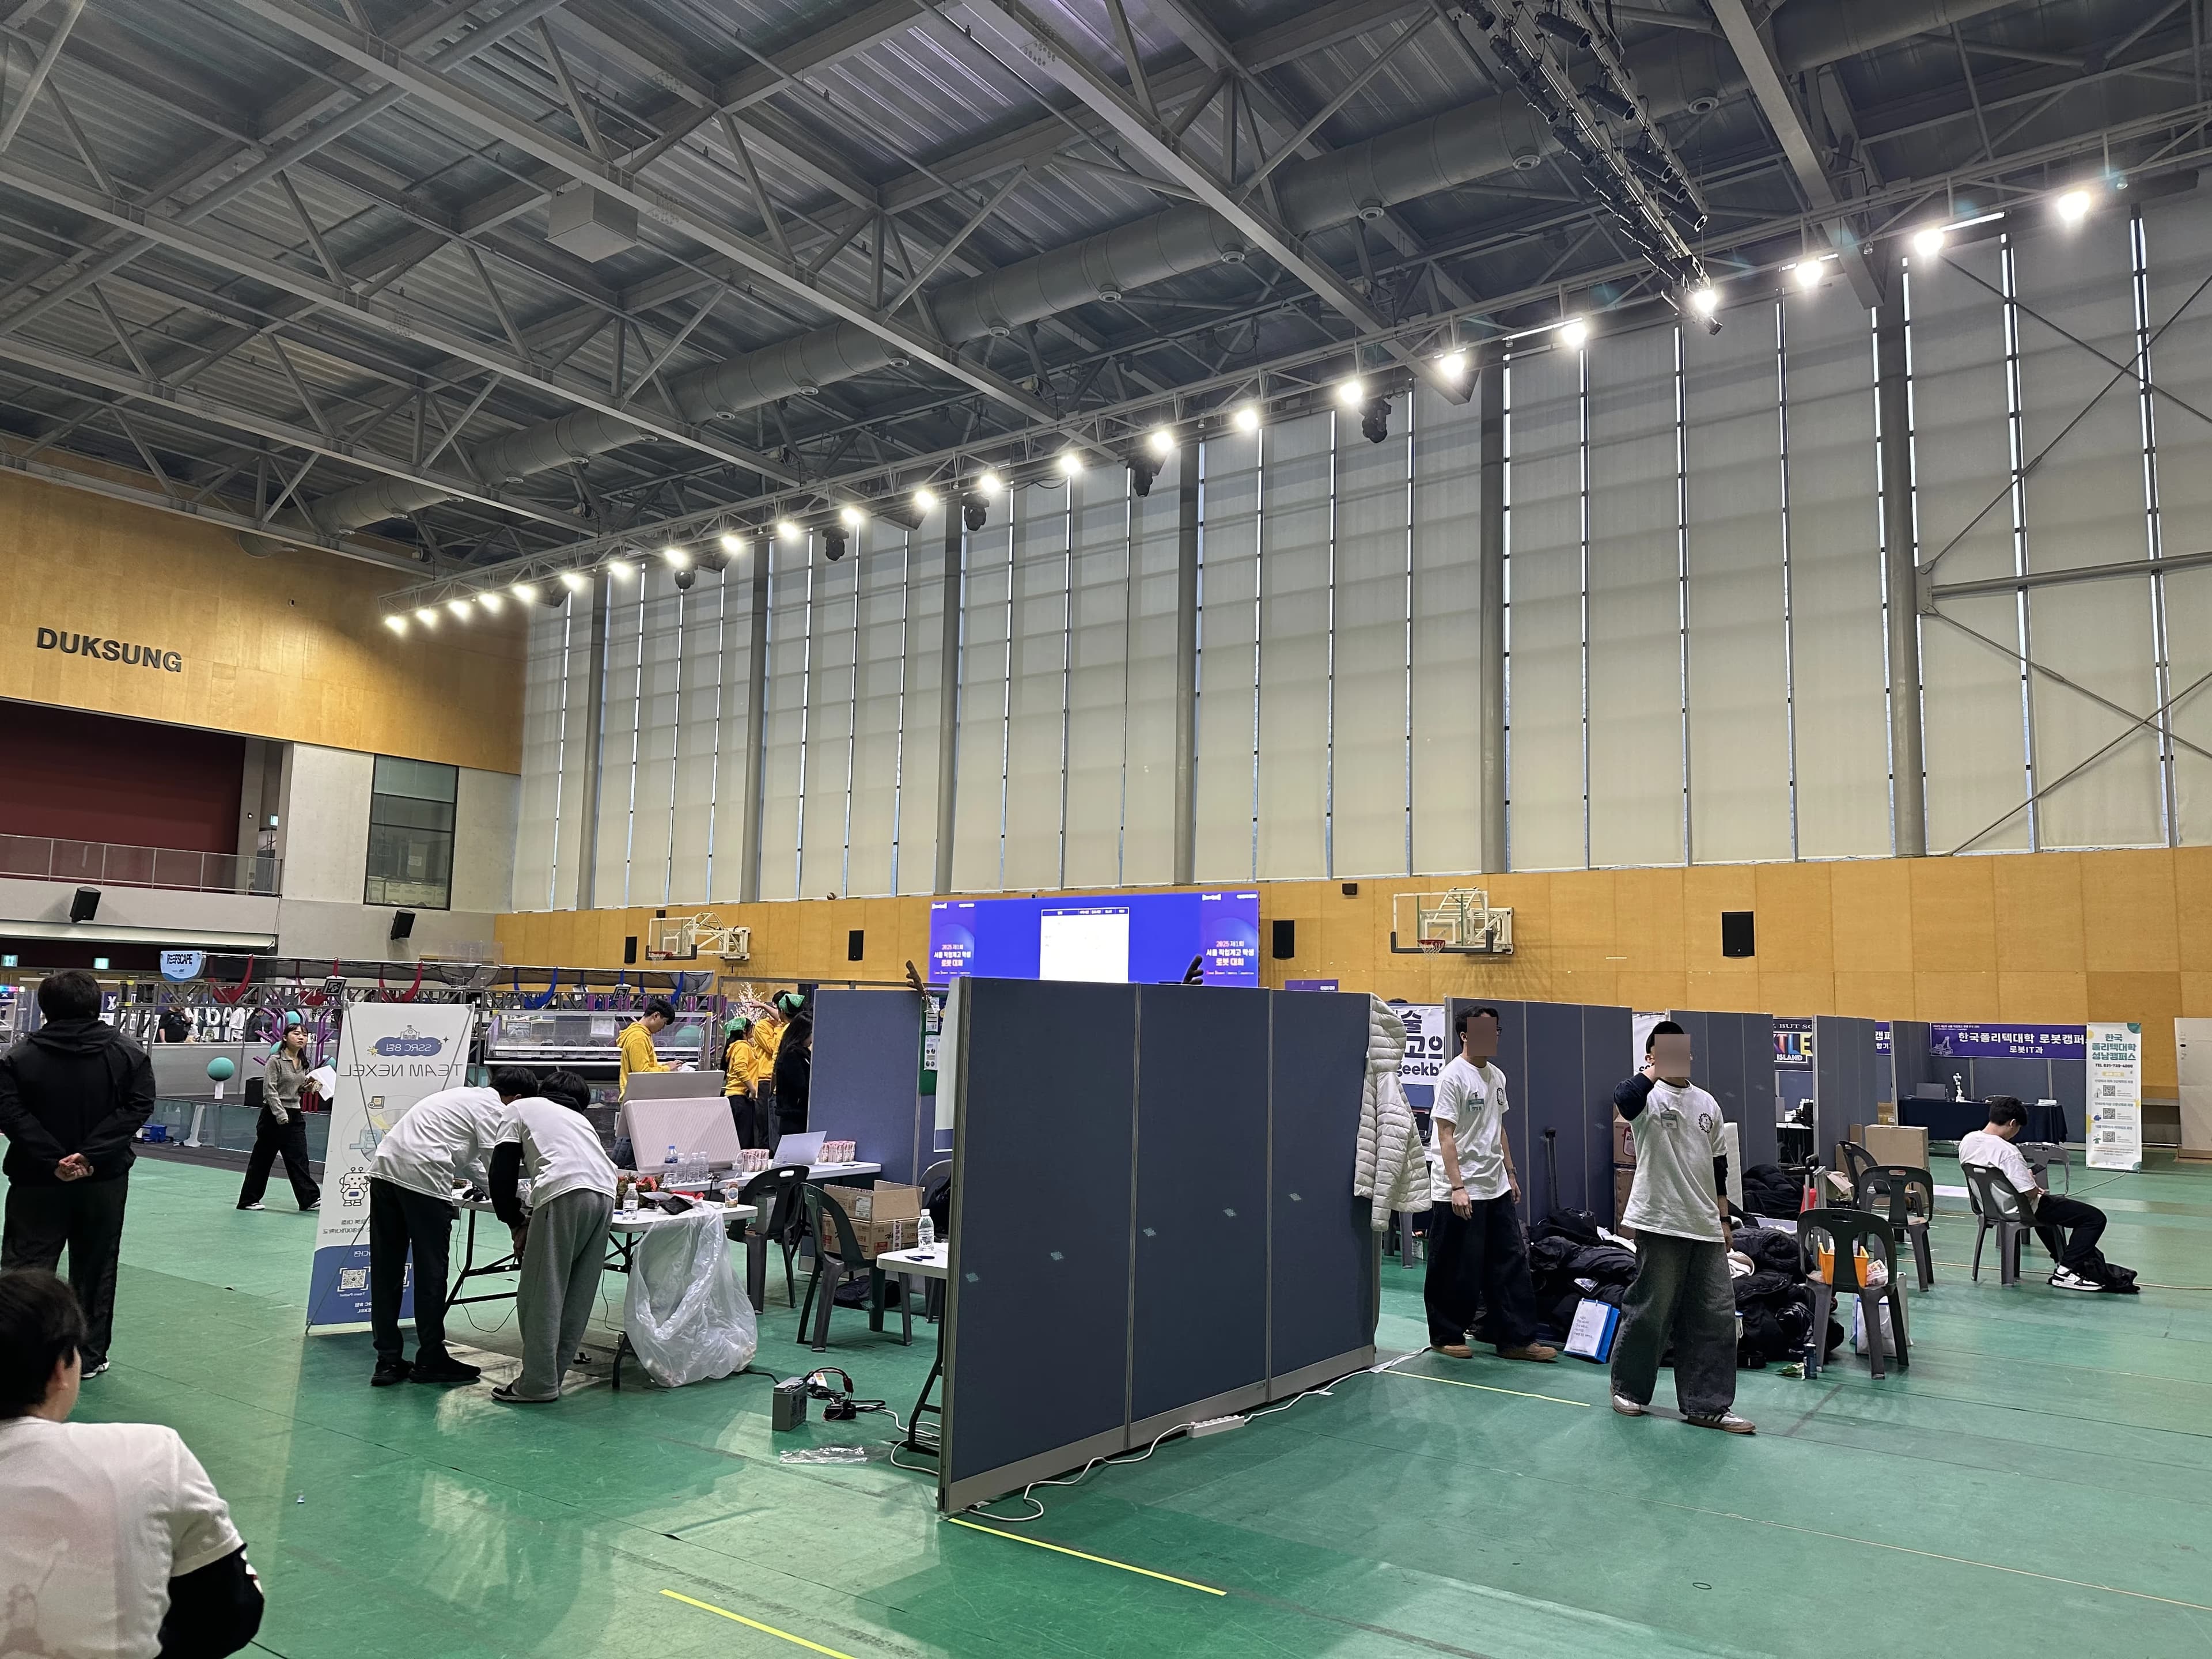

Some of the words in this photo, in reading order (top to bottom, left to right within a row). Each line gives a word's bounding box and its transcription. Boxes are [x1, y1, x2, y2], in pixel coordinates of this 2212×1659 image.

[37, 627, 181, 672] DUKSUNG
[1396, 1010, 1422, 1034] 술
[1958, 1032, 2035, 1044] 한국폴리텍대학
[2039, 1033, 2088, 1045] 로봇캠퍼
[2105, 1033, 2123, 1041] 한국
[2092, 1043, 2137, 1051] 폴리텍대학
[2092, 1052, 2136, 1060] 성남캠퍼스
[1397, 1062, 1443, 1077] geekb
